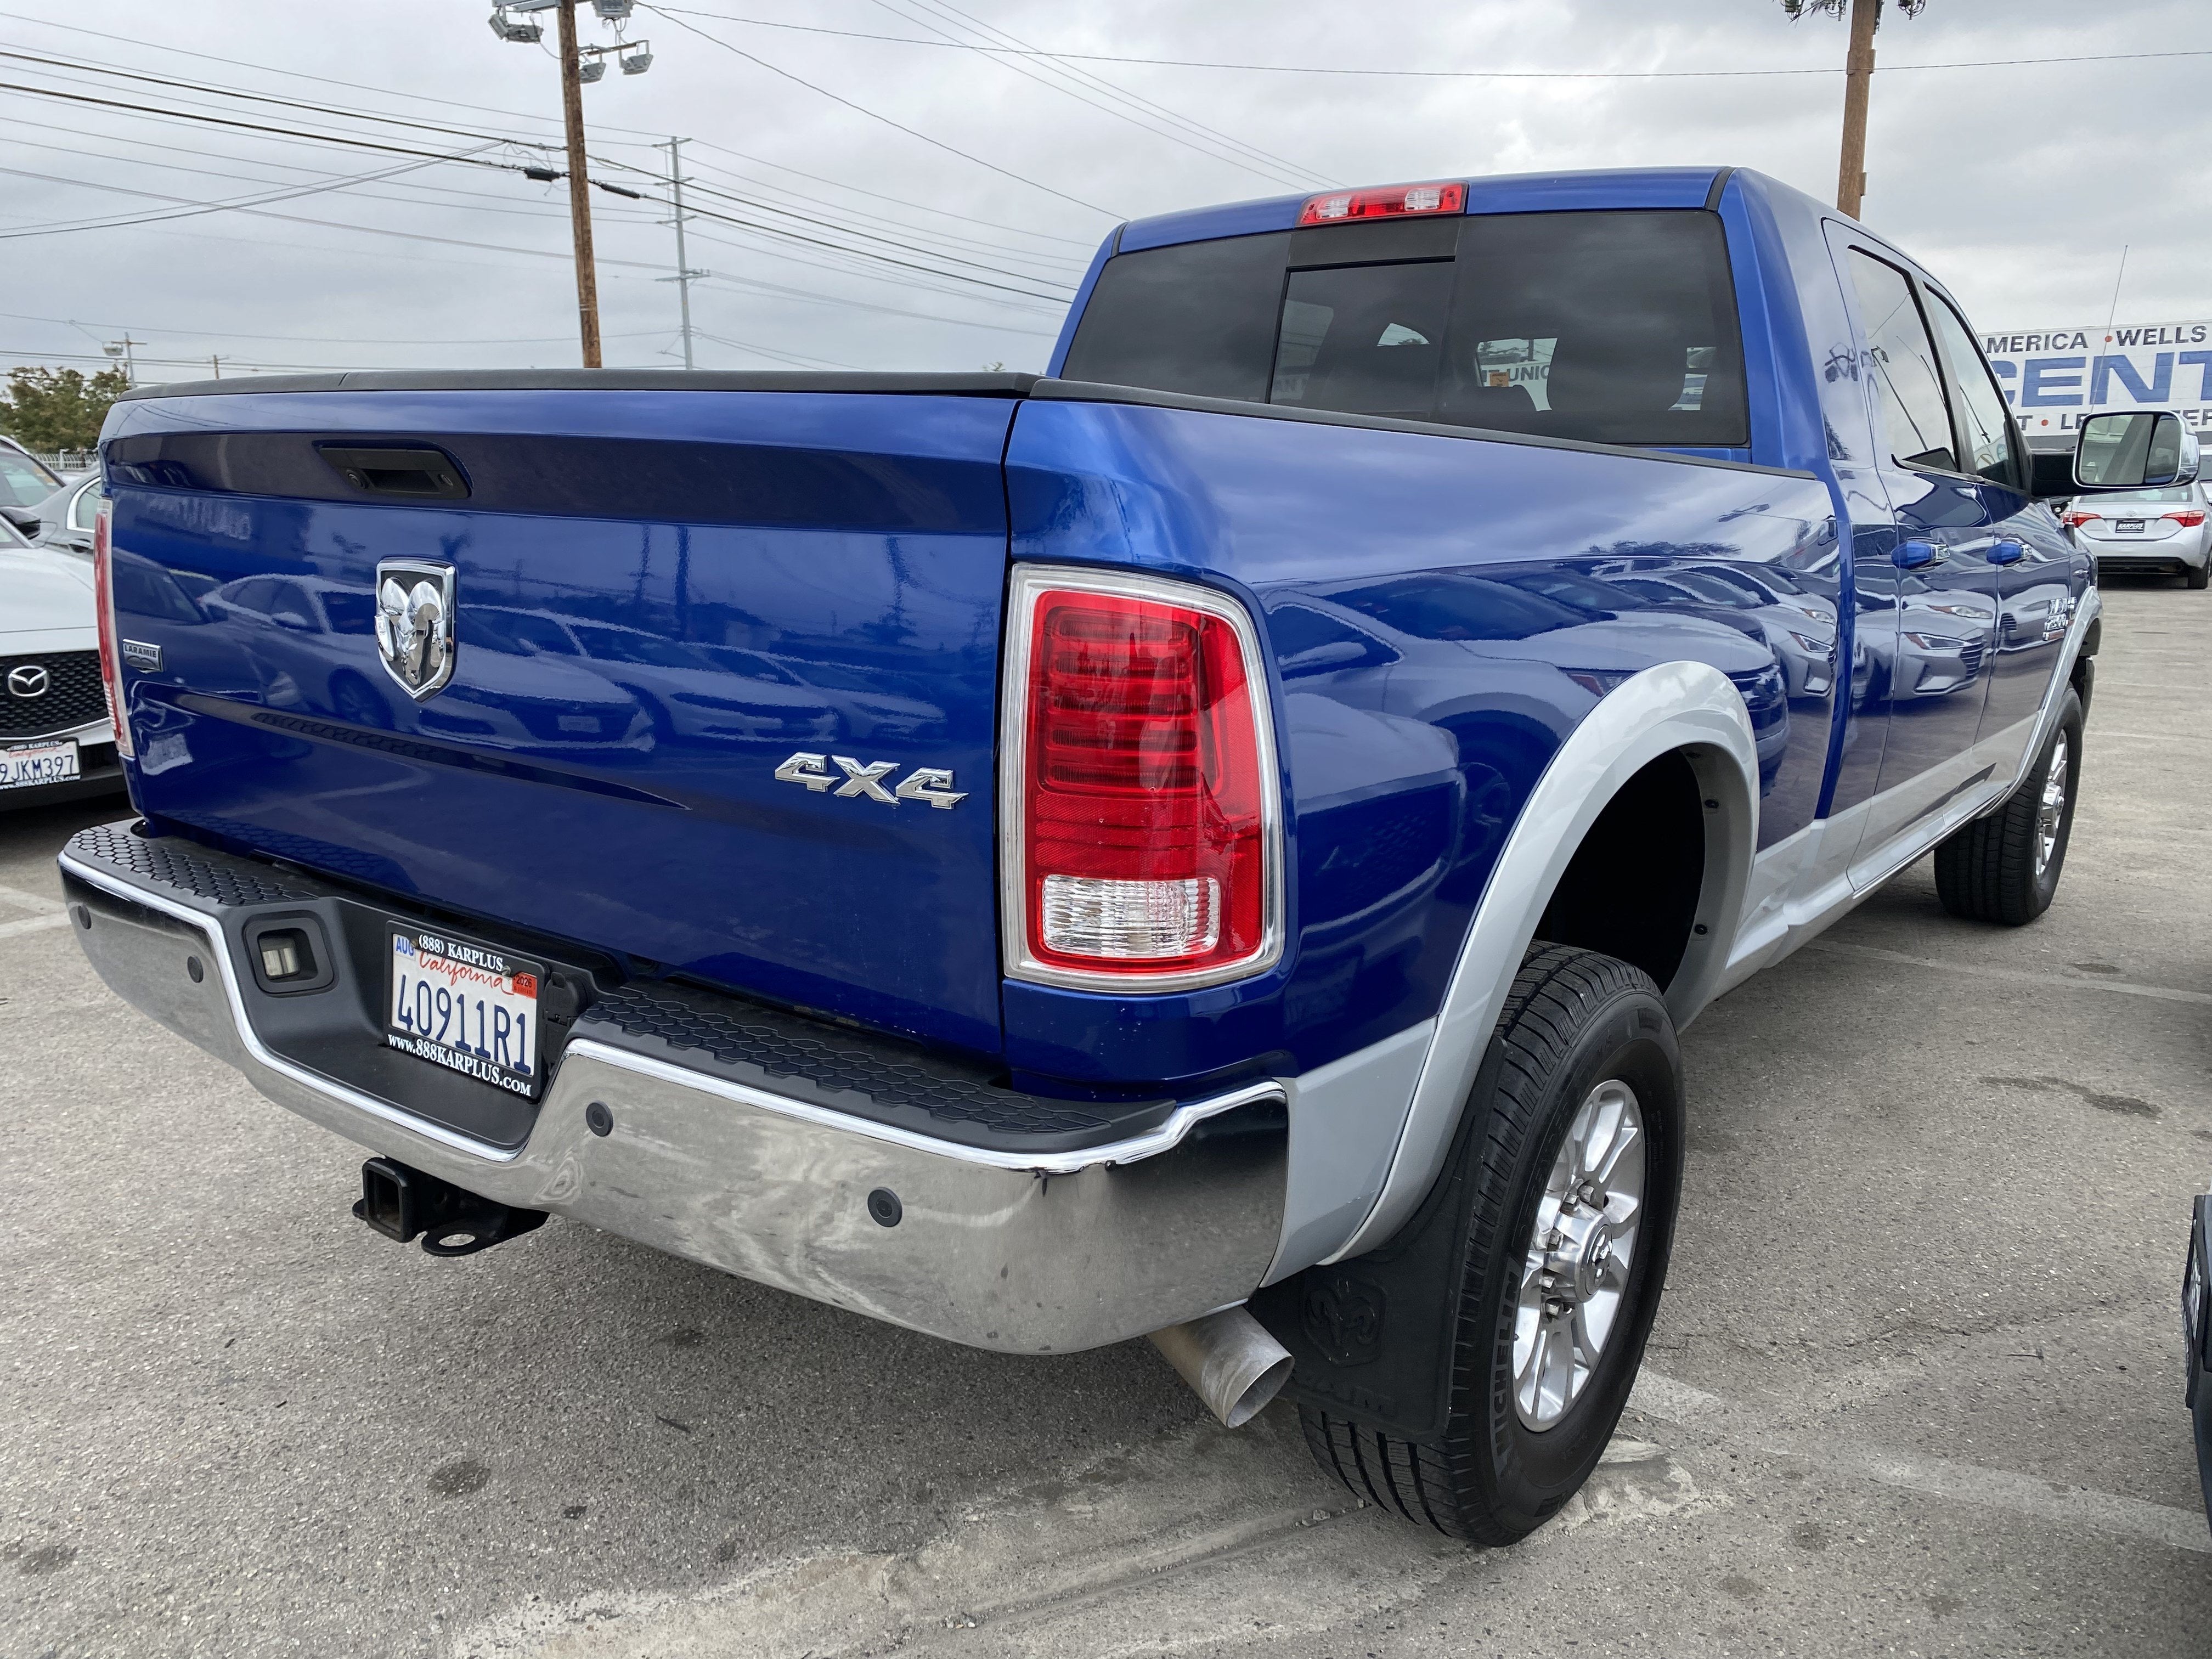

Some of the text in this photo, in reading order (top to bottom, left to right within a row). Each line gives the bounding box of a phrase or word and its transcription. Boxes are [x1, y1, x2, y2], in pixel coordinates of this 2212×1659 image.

[2115, 325, 2208, 347] WELLS
[124, 644, 157, 658] LARAMIE
[0, 754, 74, 784] 9JKM397
[419, 934, 503, 972] (888) KARPLUS
[419, 951, 514, 995] California
[516, 974, 532, 988] 2026
[398, 974, 532, 1075] 40911R1
[1493, 1271, 1520, 1457] MICHELIN
